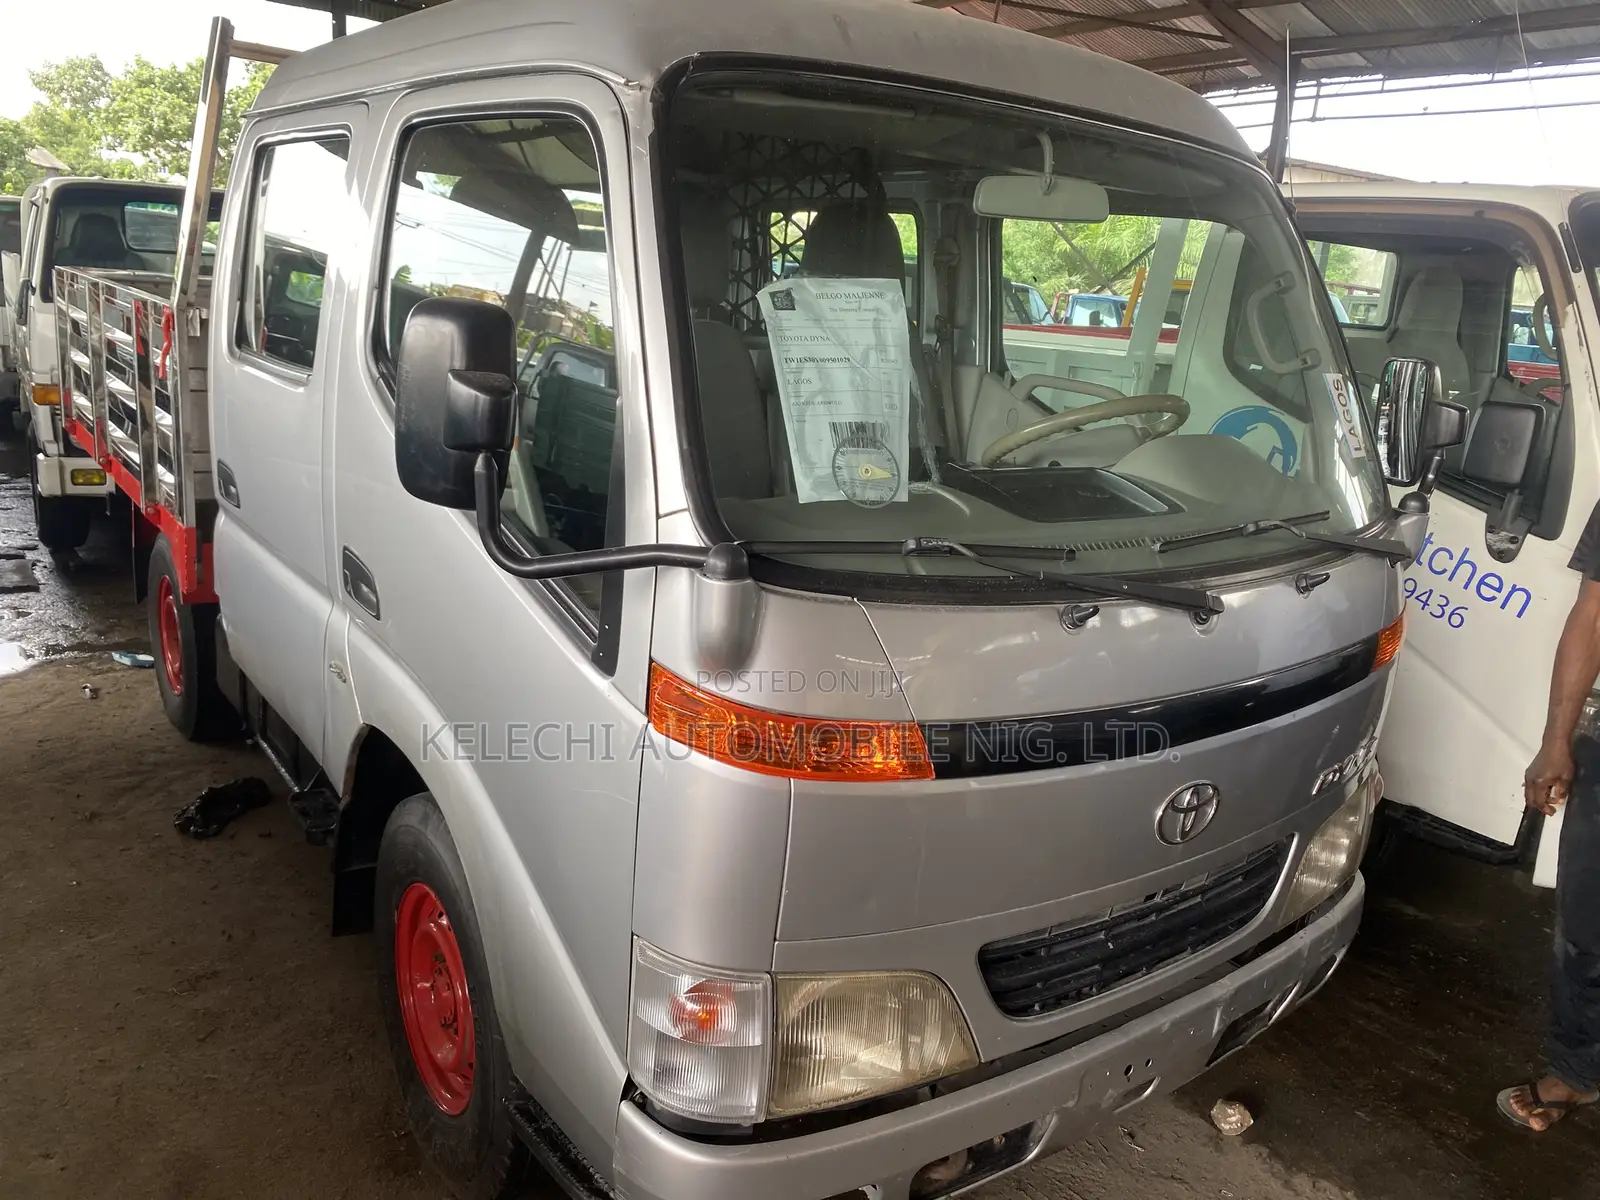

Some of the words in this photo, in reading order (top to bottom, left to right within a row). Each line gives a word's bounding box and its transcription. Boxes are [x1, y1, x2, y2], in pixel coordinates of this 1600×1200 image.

[815, 292, 843, 300] BELGO
[844, 291, 885, 299] MALIENNE
[787, 377, 812, 385] LAGOS
[1332, 378, 1363, 452] LAGOS
